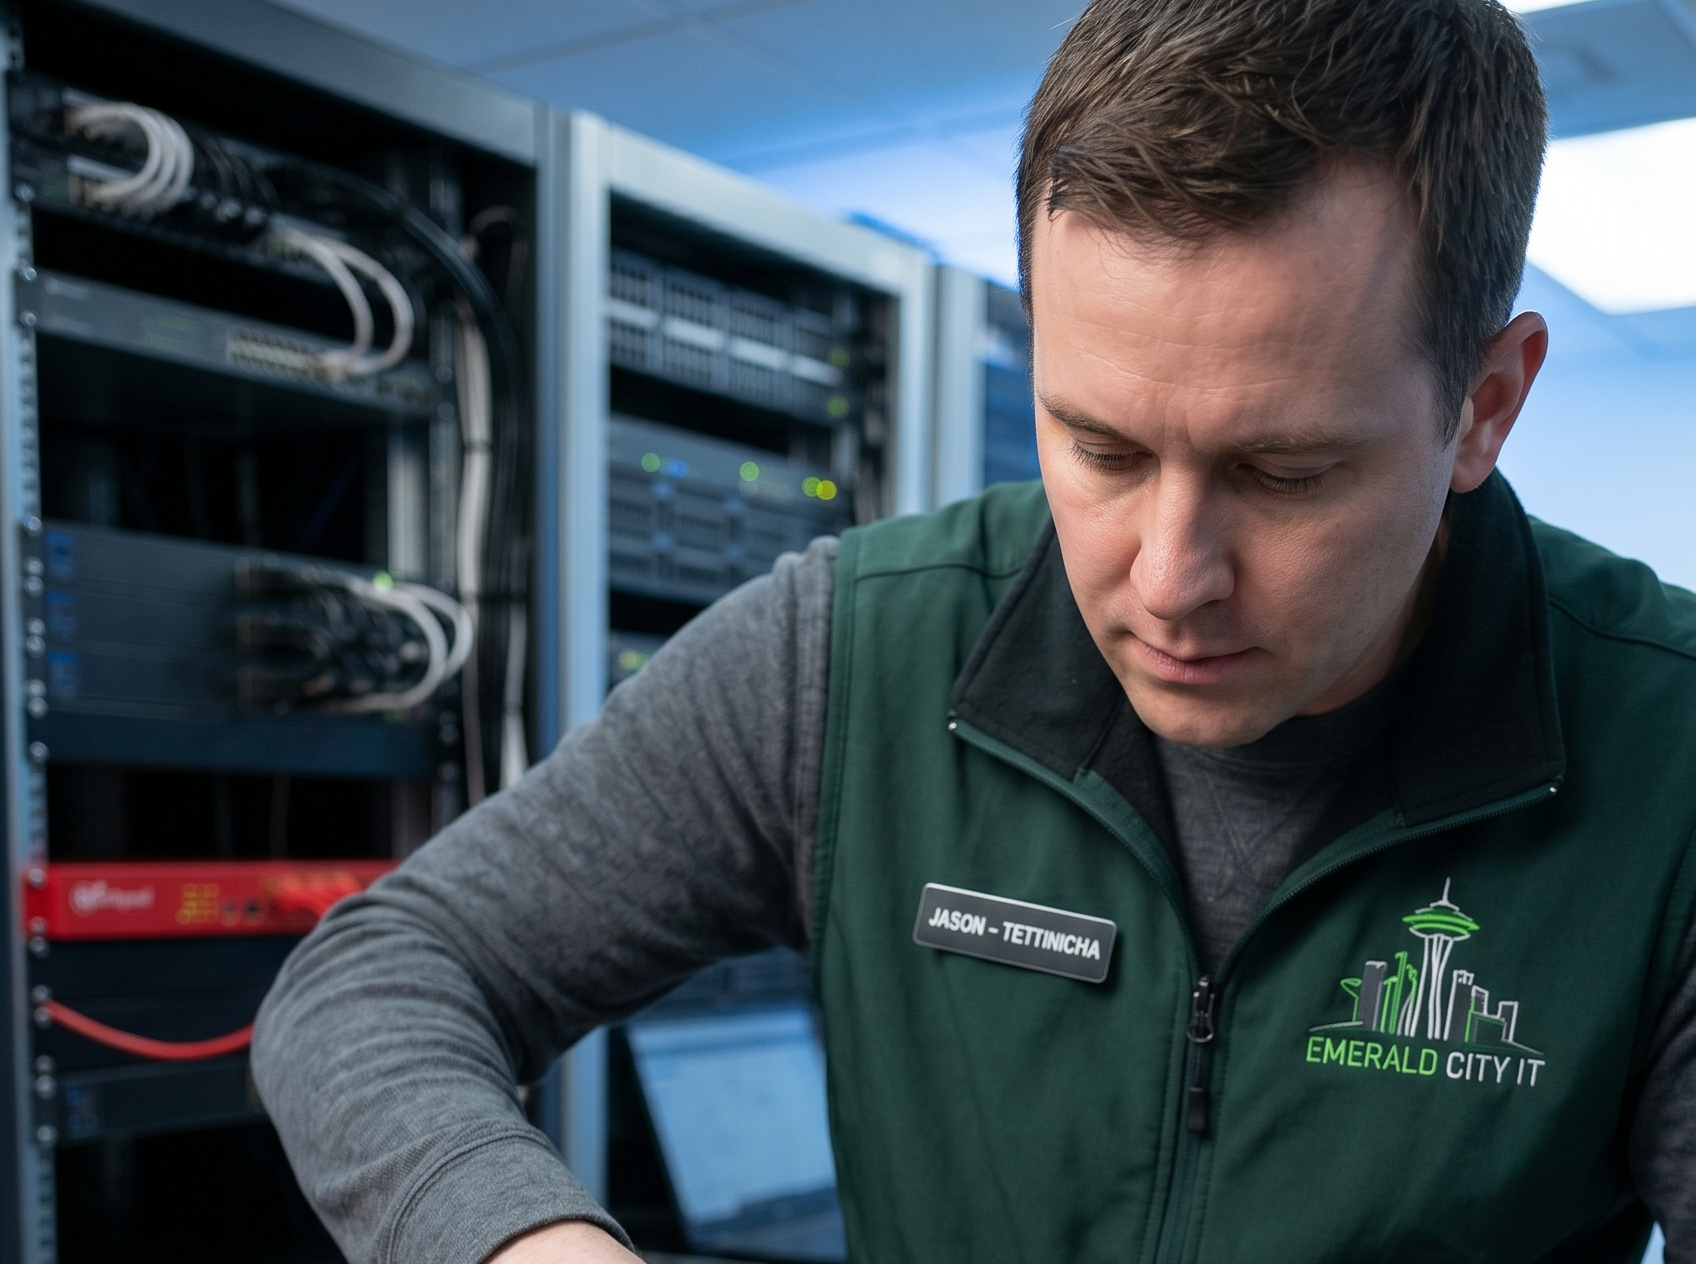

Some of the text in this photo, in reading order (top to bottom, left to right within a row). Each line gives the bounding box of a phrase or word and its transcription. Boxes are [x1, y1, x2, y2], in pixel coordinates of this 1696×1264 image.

[929, 907, 986, 936] JASON
[1002, 921, 1101, 961] TETTINICHA
[1306, 1036, 1546, 1087] EMERALD CITY IT
